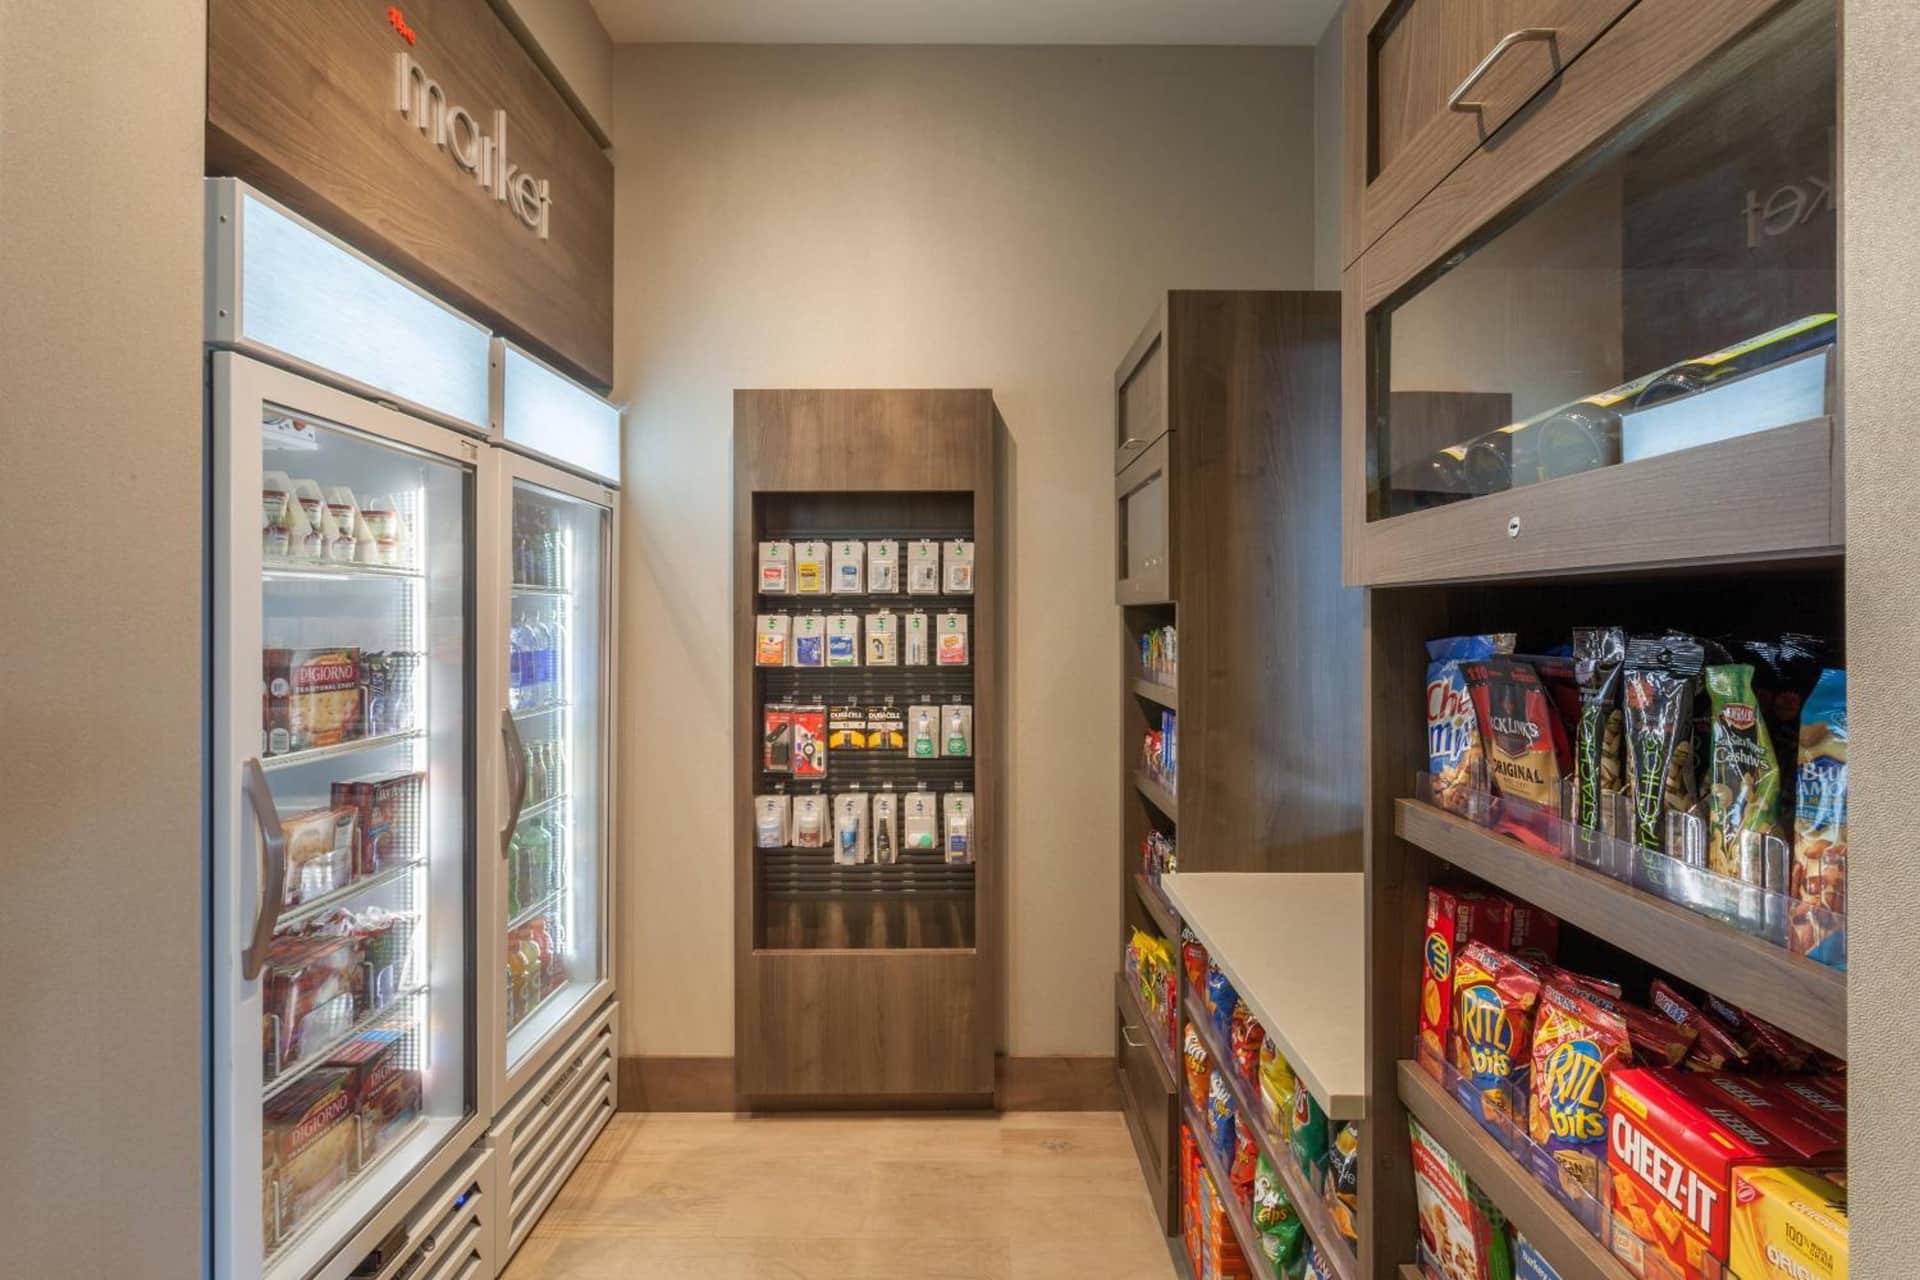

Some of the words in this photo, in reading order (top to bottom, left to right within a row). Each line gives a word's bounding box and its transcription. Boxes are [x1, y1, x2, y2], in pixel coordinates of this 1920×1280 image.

[394, 52, 553, 240] market
[300, 664, 353, 683] DIGIORNO
[1427, 676, 1474, 724] Che
[1715, 746, 1769, 770] Cashews
[1430, 936, 1448, 981] RITZ
[1461, 989, 1508, 1051] RITZ
[1470, 1047, 1512, 1076] bits
[1549, 1043, 1604, 1109] RITZ
[292, 1094, 349, 1145] DIGIORNO
[1549, 1108, 1606, 1139] bits
[1611, 1112, 1717, 1235] CHEEZ-IT
[1766, 1244, 1821, 1280] ORIG
